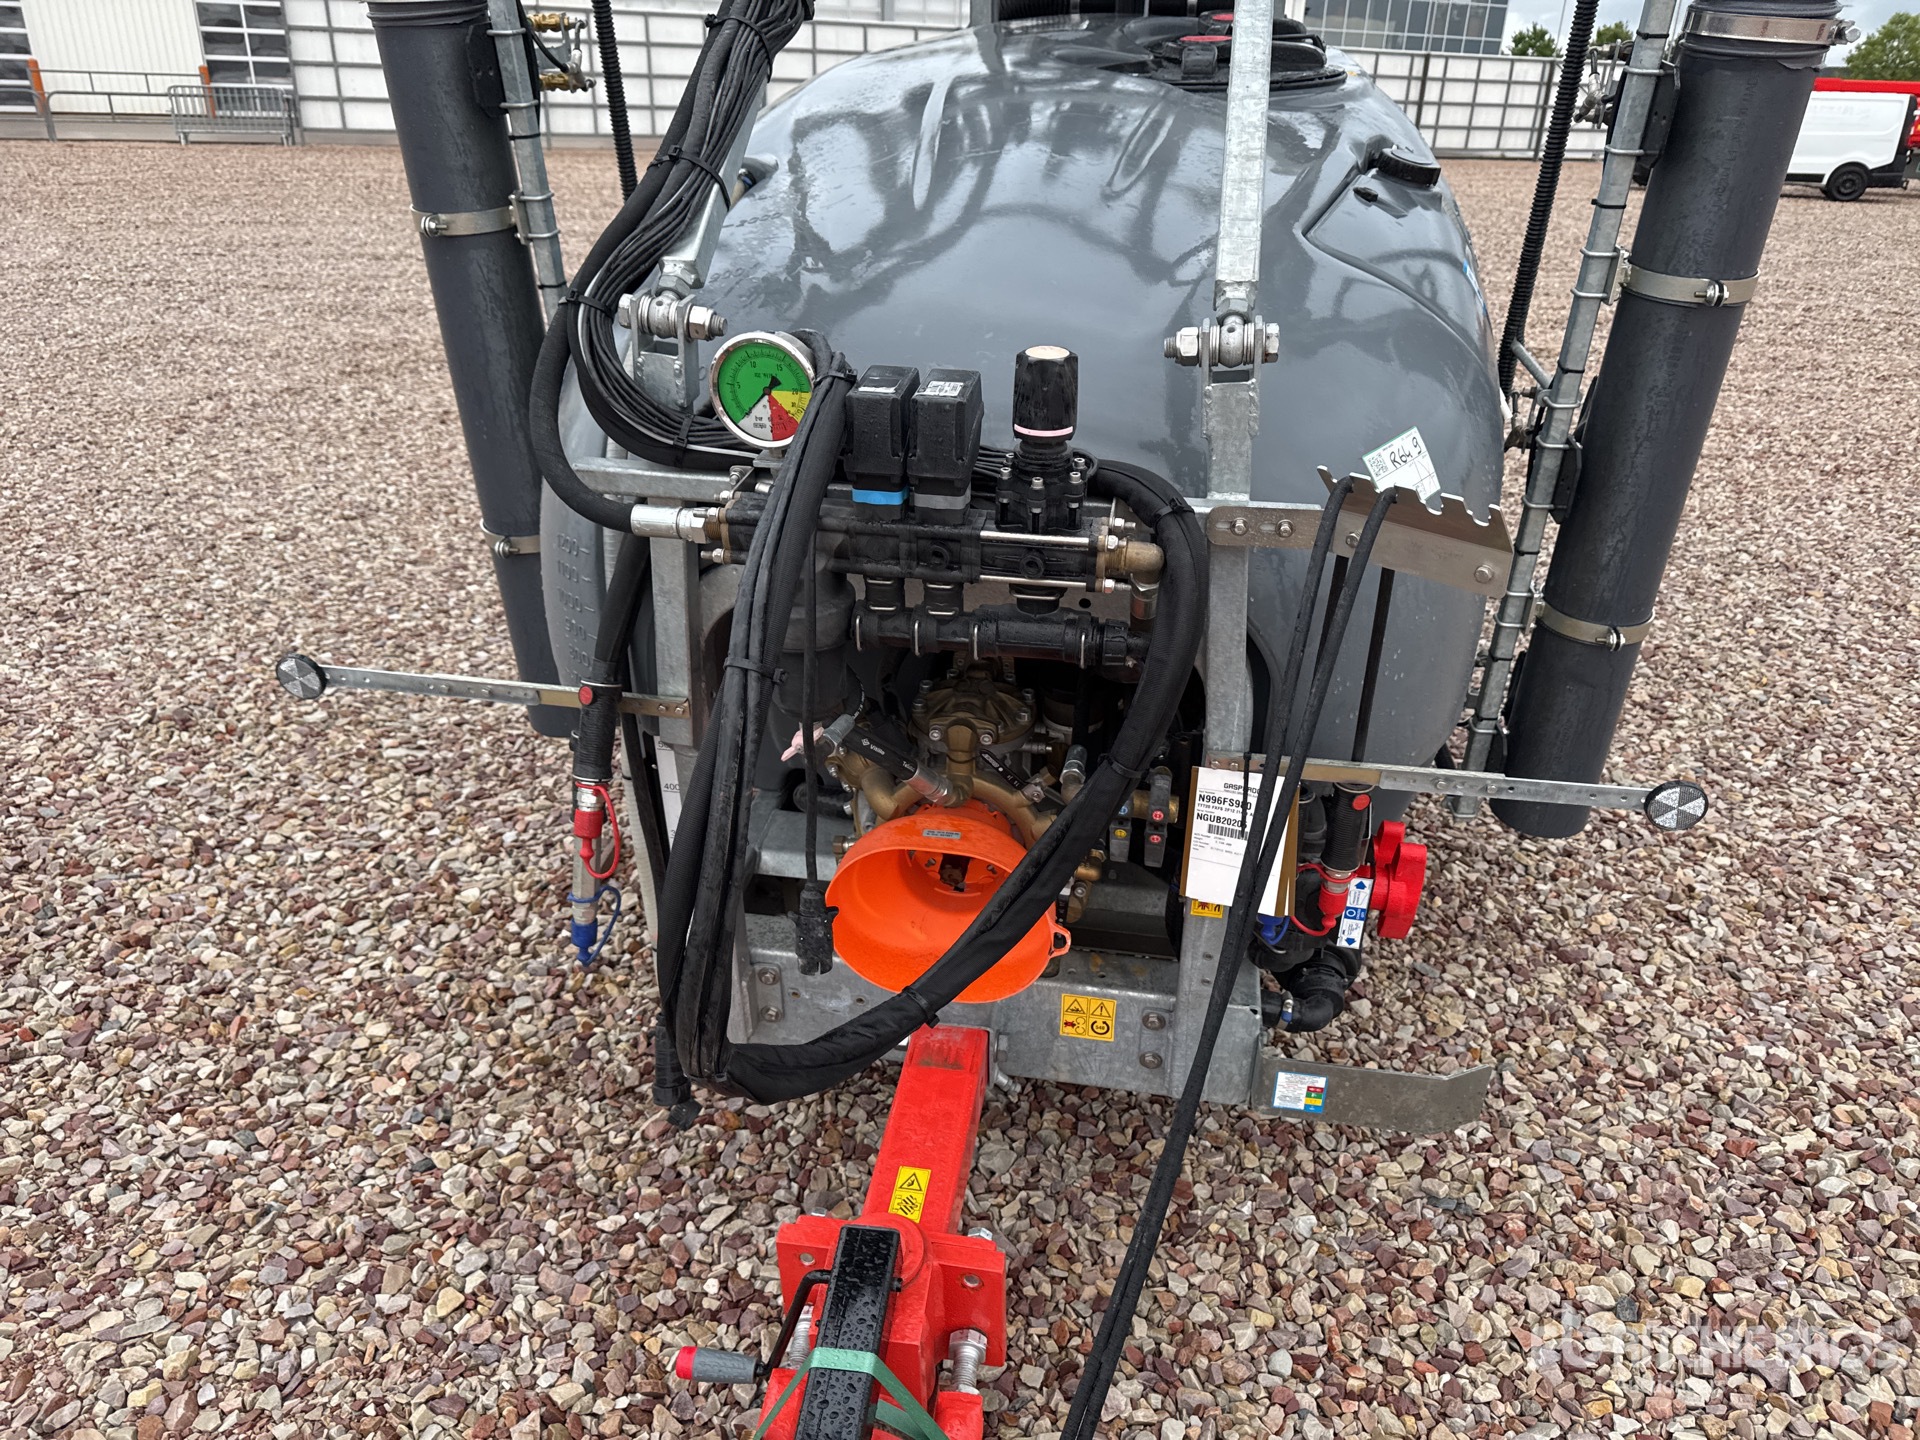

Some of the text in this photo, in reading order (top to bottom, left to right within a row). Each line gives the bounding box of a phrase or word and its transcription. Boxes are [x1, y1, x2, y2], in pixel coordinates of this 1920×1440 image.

[750, 361, 757, 369] 10
[557, 532, 578, 557] 1200
[1199, 794, 1252, 810] N996FS90
[1197, 812, 1247, 829] NGUB2020
